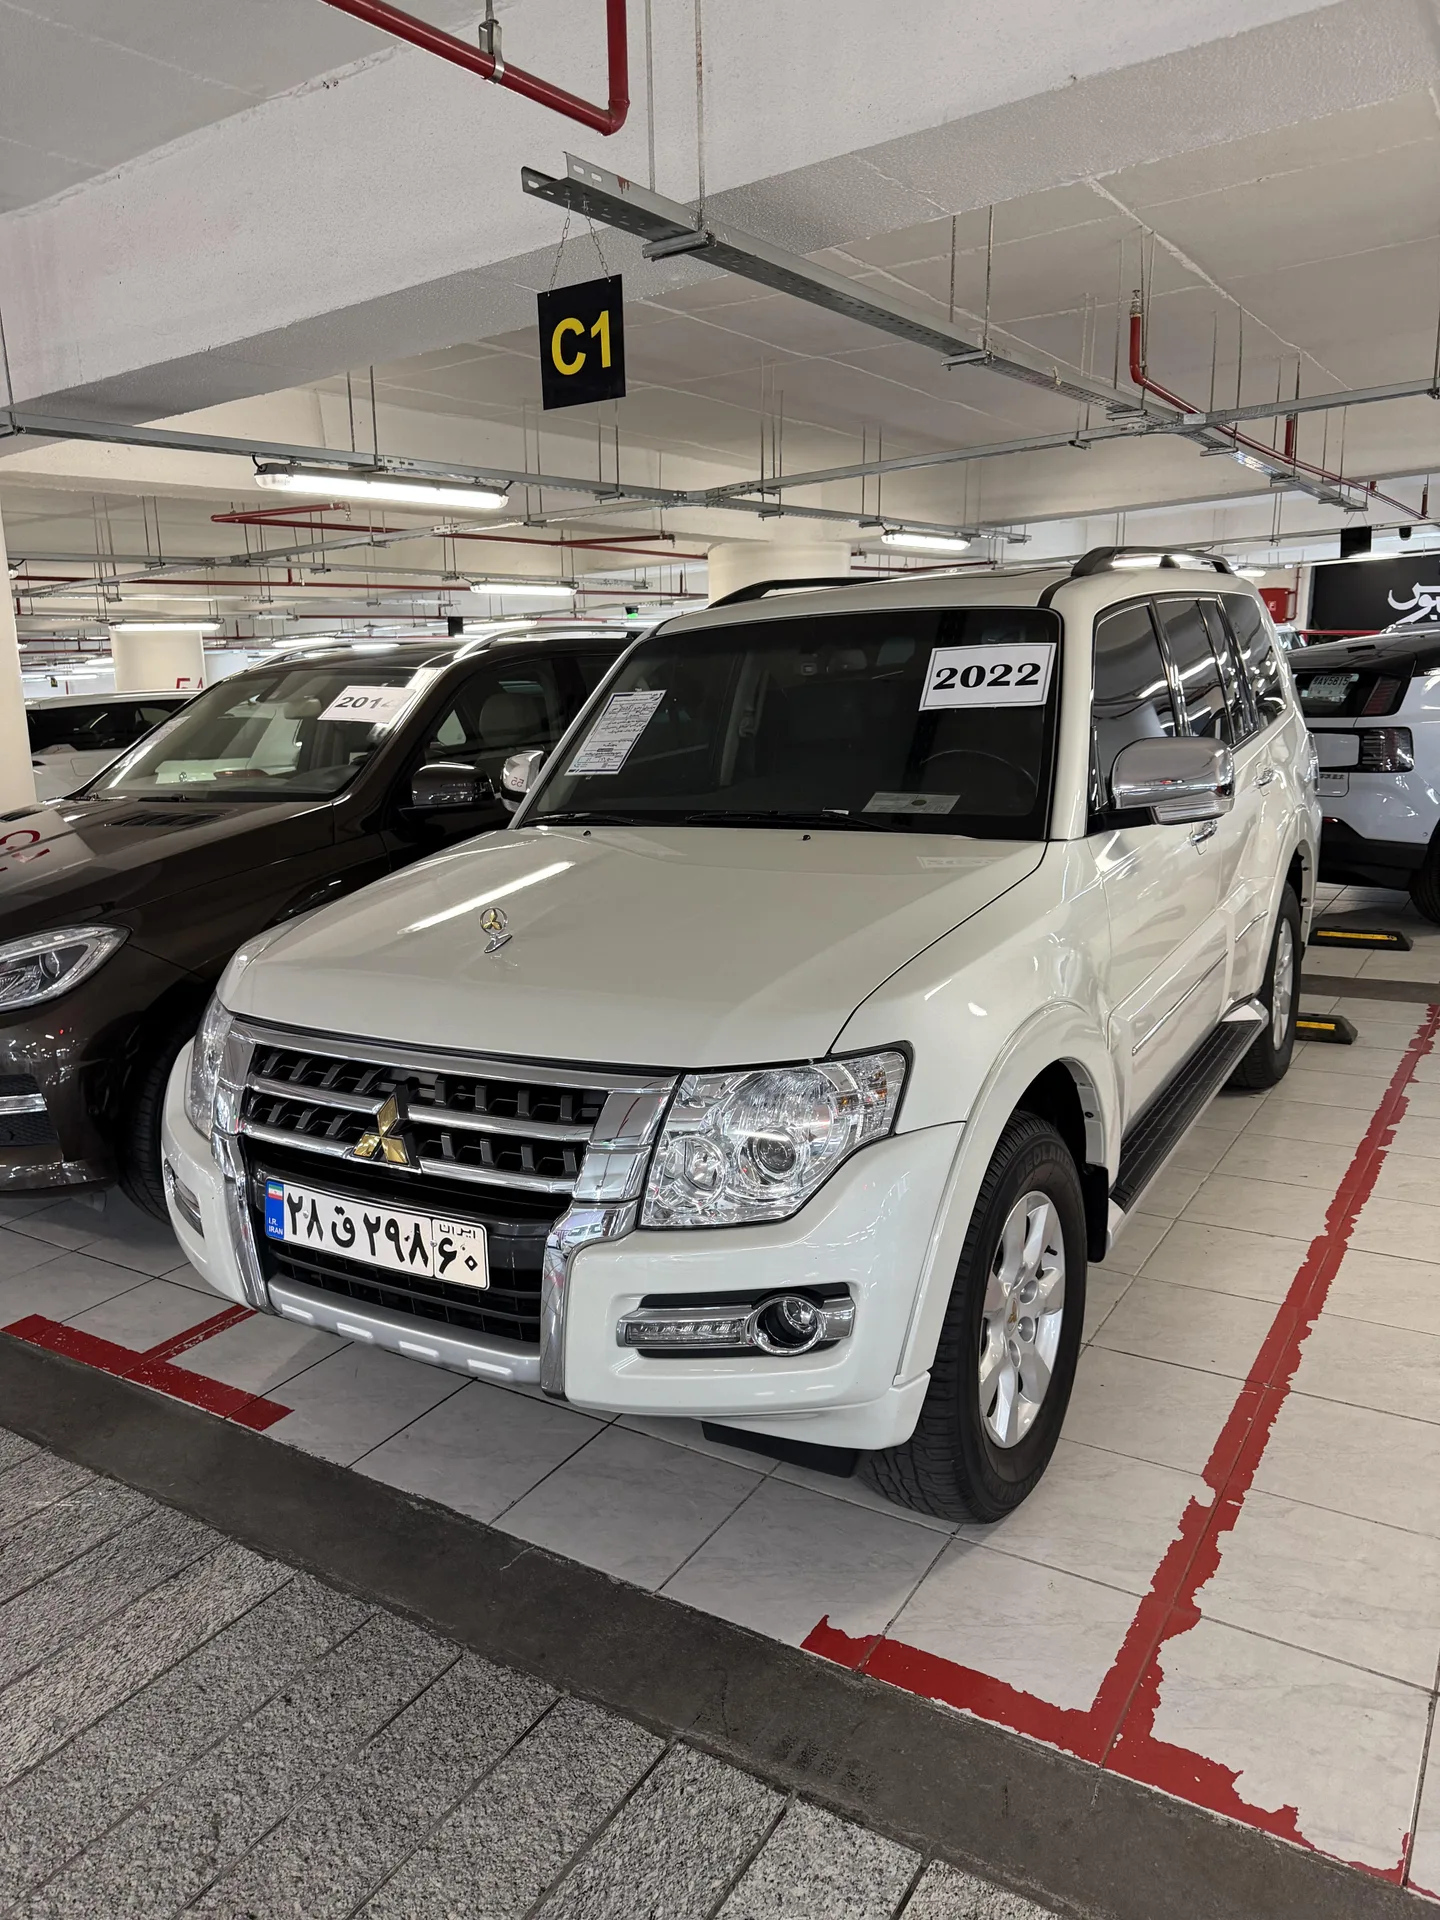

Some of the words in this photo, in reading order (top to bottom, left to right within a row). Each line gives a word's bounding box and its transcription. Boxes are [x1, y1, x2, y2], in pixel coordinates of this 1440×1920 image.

[551, 310, 611, 375] C1
[932, 663, 1041, 690] 2022
[268, 1217, 279, 1227] I.R.
[268, 1225, 284, 1236] IRAN
[439, 1223, 477, 1239] ایران
